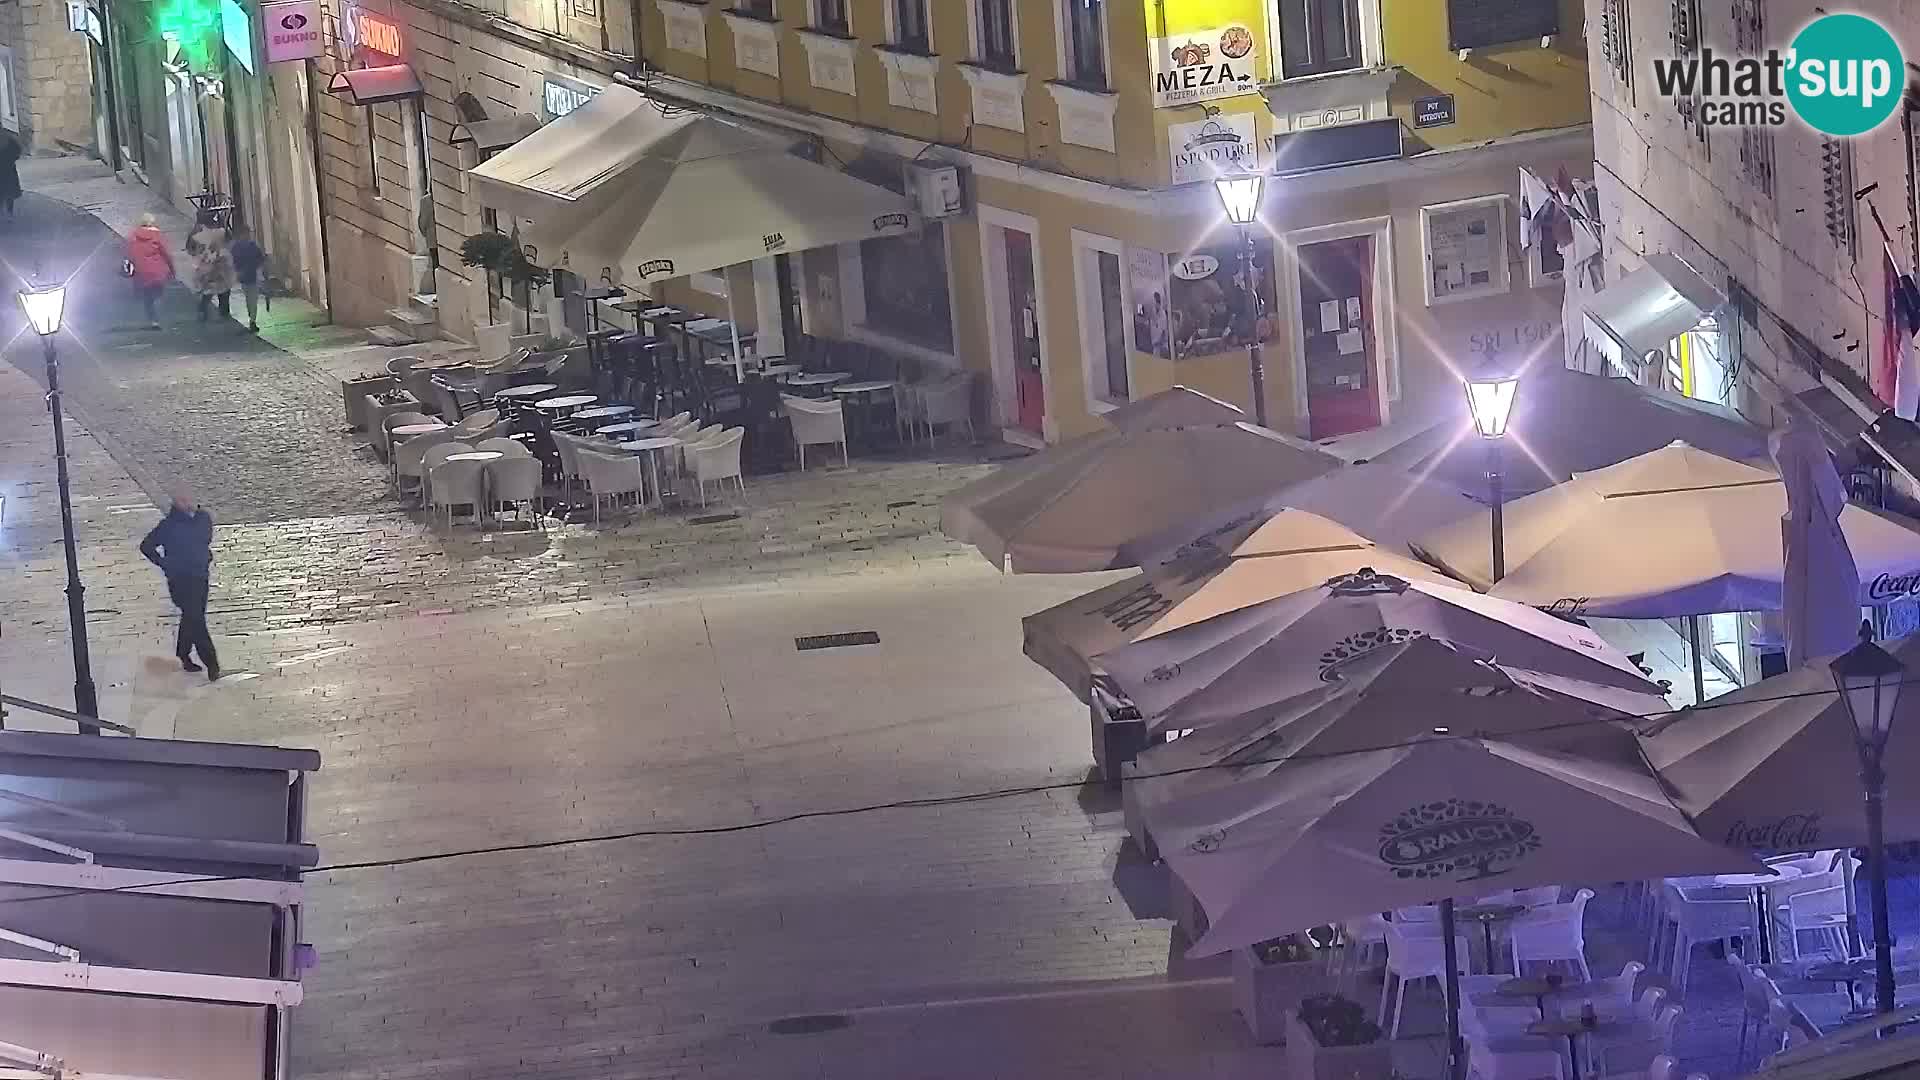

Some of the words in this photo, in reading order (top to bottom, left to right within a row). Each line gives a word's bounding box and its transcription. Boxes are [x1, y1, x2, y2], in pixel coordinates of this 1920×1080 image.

[273, 32, 318, 45] SUKNO
[359, 15, 400, 57] SUKNO
[1157, 63, 1236, 93] MEZA
[1166, 89, 1198, 101] PIZZERIA
[1206, 84, 1227, 96] GRILL
[1175, 148, 1220, 167] ISPOD
[763, 231, 784, 247] ŽUJA
[1422, 821, 1518, 855] RAUCH
